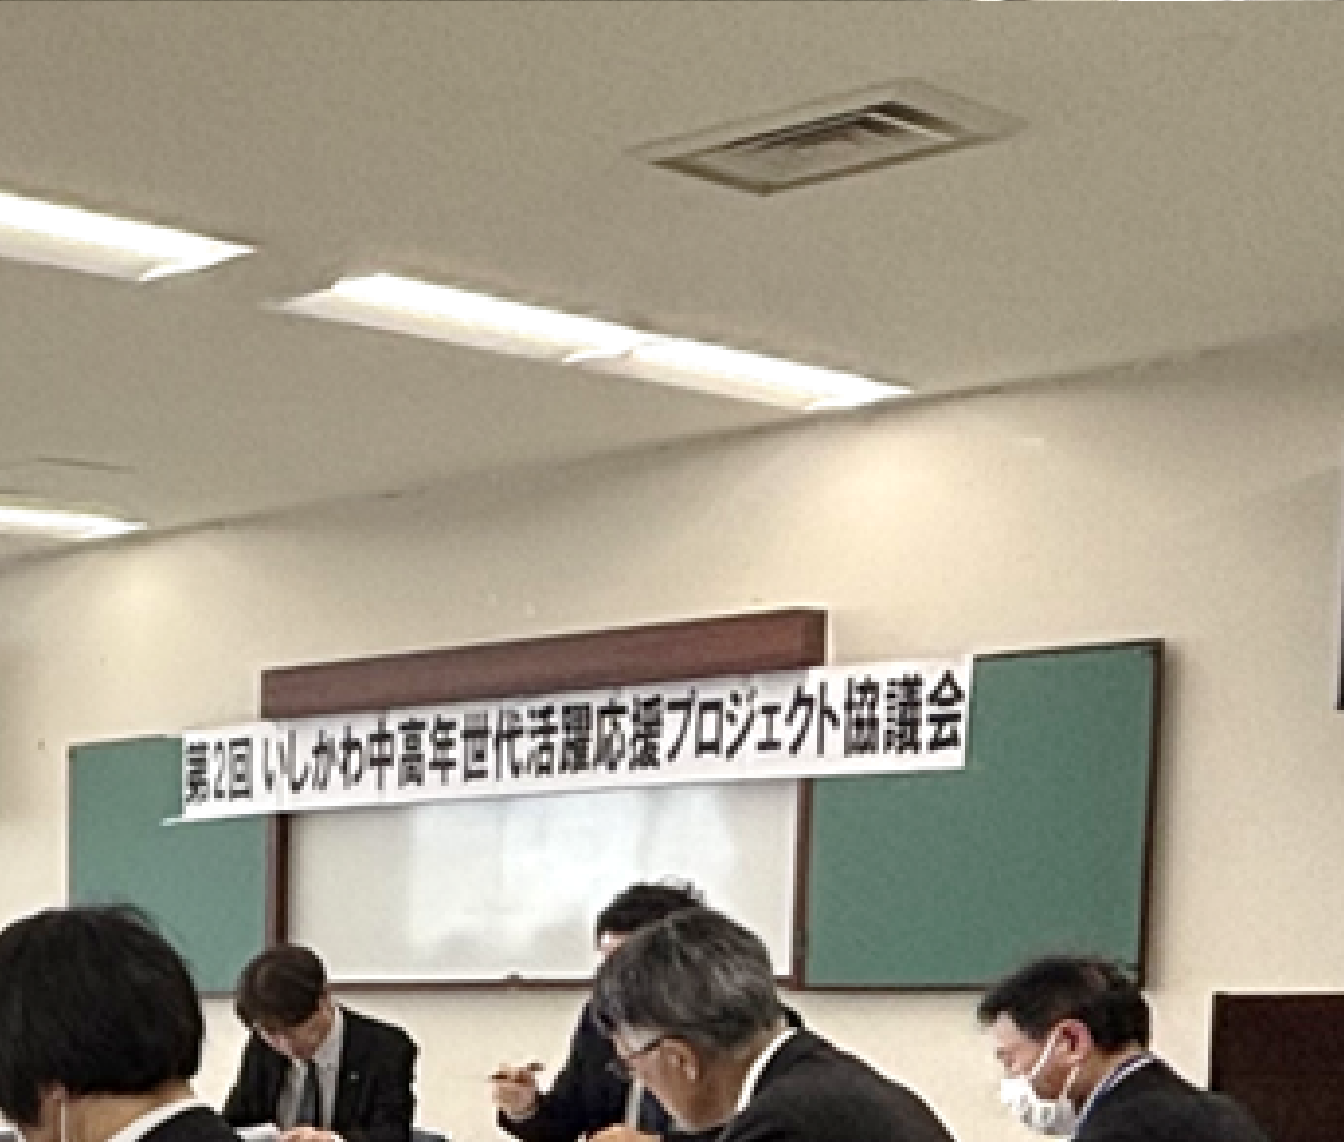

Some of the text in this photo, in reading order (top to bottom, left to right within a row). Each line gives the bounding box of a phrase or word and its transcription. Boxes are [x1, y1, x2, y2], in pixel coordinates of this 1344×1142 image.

[184, 667, 966, 804] 第2回 いしかわ中高年世代活躍応援プロジェクト協議会
